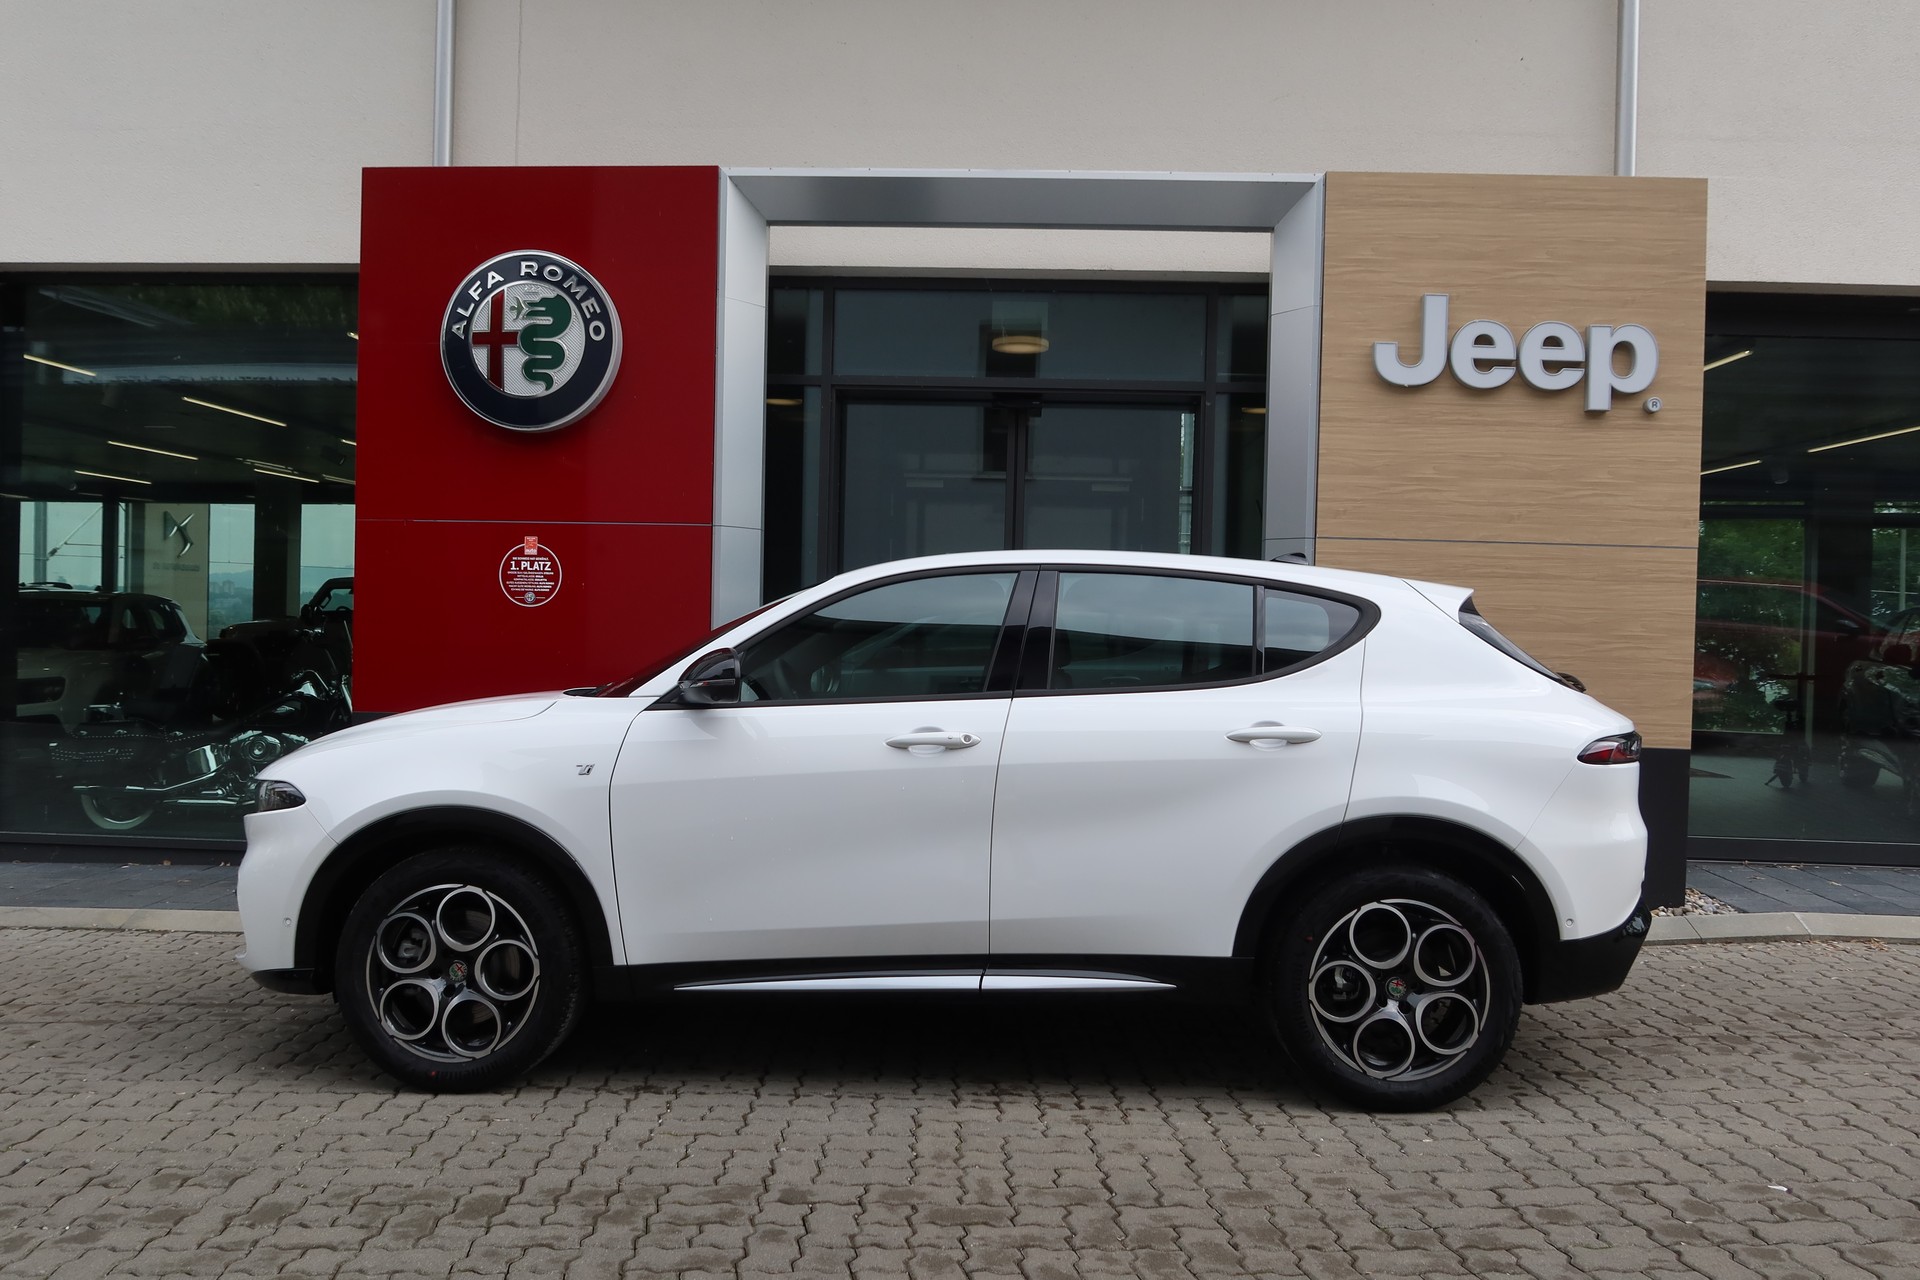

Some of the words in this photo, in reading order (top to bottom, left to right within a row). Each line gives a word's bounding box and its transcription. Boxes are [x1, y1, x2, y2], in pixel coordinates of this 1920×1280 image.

[451, 270, 504, 340] ALFA
[520, 261, 606, 341] ROMEO
[1371, 293, 1659, 412] Jeep
[510, 561, 519, 571] 1.
[521, 561, 551, 571] PLATZ
